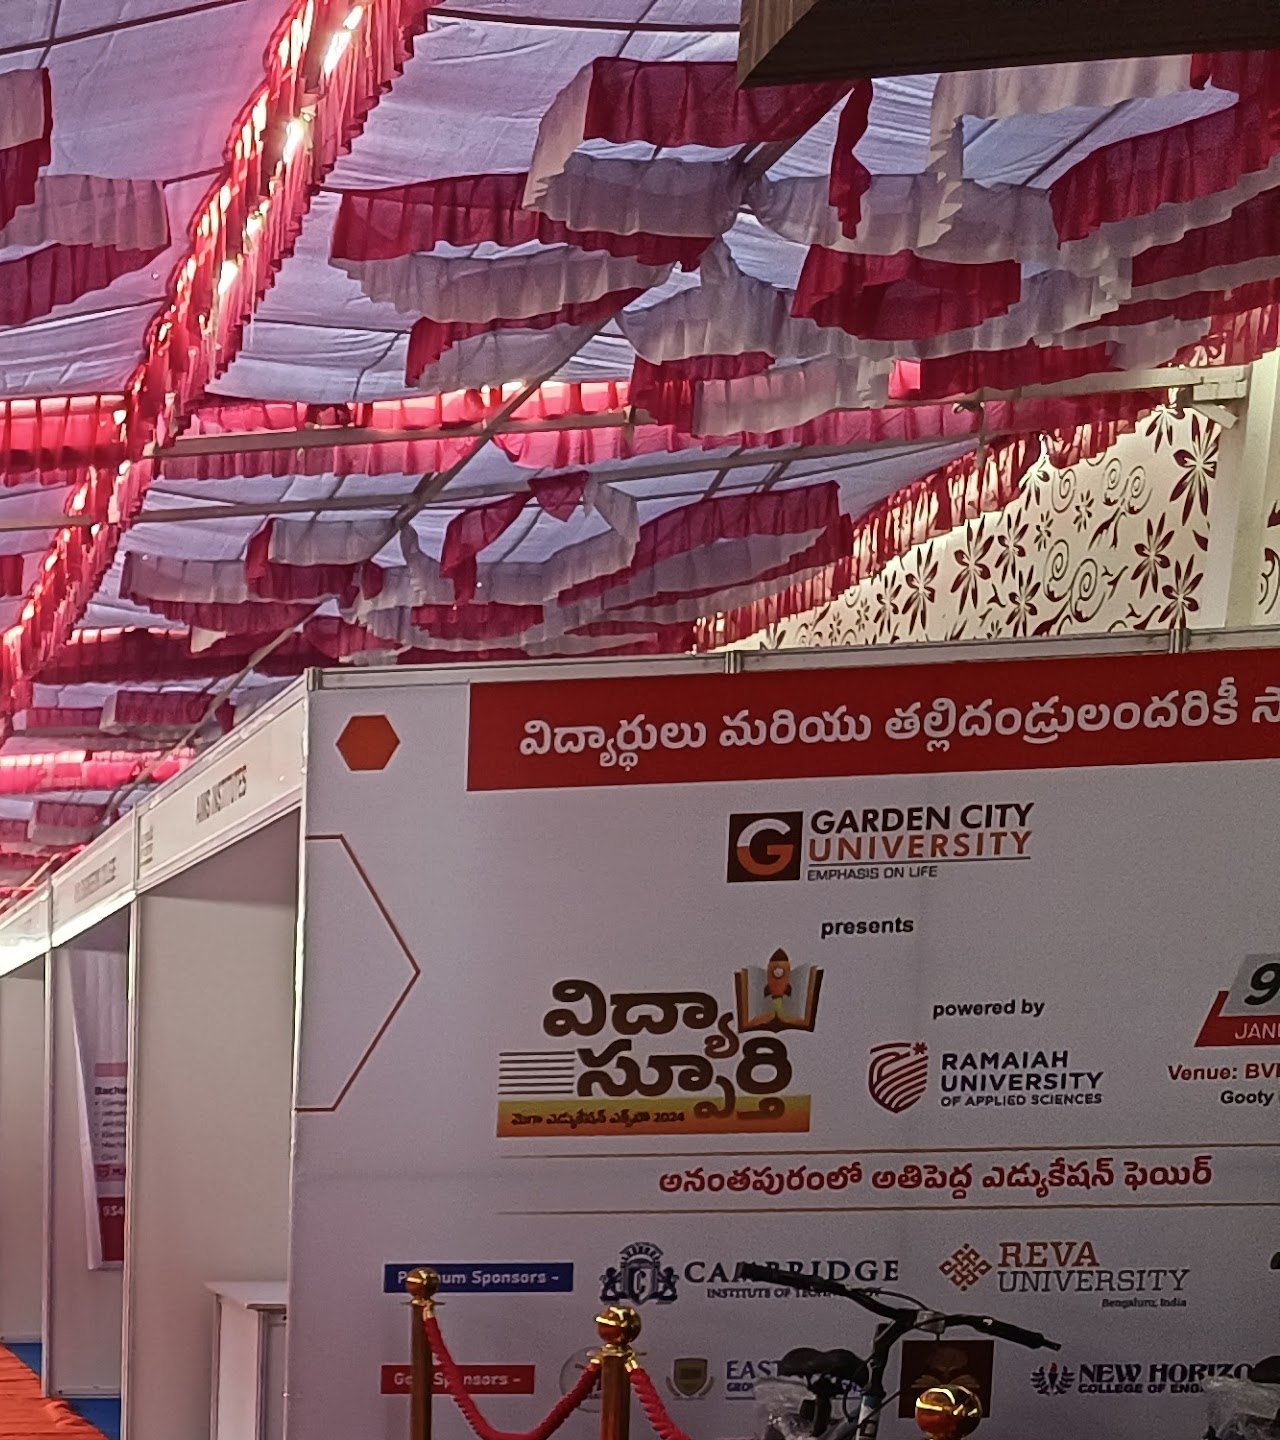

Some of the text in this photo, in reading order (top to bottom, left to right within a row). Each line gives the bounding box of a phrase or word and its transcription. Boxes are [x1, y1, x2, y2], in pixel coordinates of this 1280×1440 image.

[519, 714, 707, 771] విద్యార్థులు
[719, 705, 872, 747] మరియు
[885, 677, 1239, 752] తల్లిదండ్రులందరికీ
[811, 802, 1034, 834] GARDEN CITY
[809, 831, 1032, 861] UNIVERSITY
[807, 865, 938, 881] EMPHASIS ON LIFE
[821, 916, 914, 939] presents
[543, 978, 739, 1058] విద్యా
[933, 1000, 1045, 1019] powered by
[942, 1050, 1068, 1070] RAMAIAH
[941, 1072, 1104, 1092] UNIVERSITY
[1168, 1064, 1238, 1081] Venue:
[941, 1093, 1102, 1107] OF APPLIED SCIENCES
[1220, 1090, 1275, 1107] Gooty
[653, 1112, 685, 1123] 2024
[659, 1155, 1213, 1200] అనంతపురంలో అతిపెద్ద ఎడ్యుకేషన్ ఫెయిర్
[998, 1241, 1100, 1267] REVA
[471, 1269, 547, 1287] Sponsors
[997, 1268, 1190, 1293] UNIVERSITY
[706, 1287, 770, 1299] INSTITUTE
[433, 1372, 509, 1388] Spnsors
[1078, 1363, 1254, 1383] NEW HORIZO
[1078, 1383, 1166, 1394] COLLEGE OF
